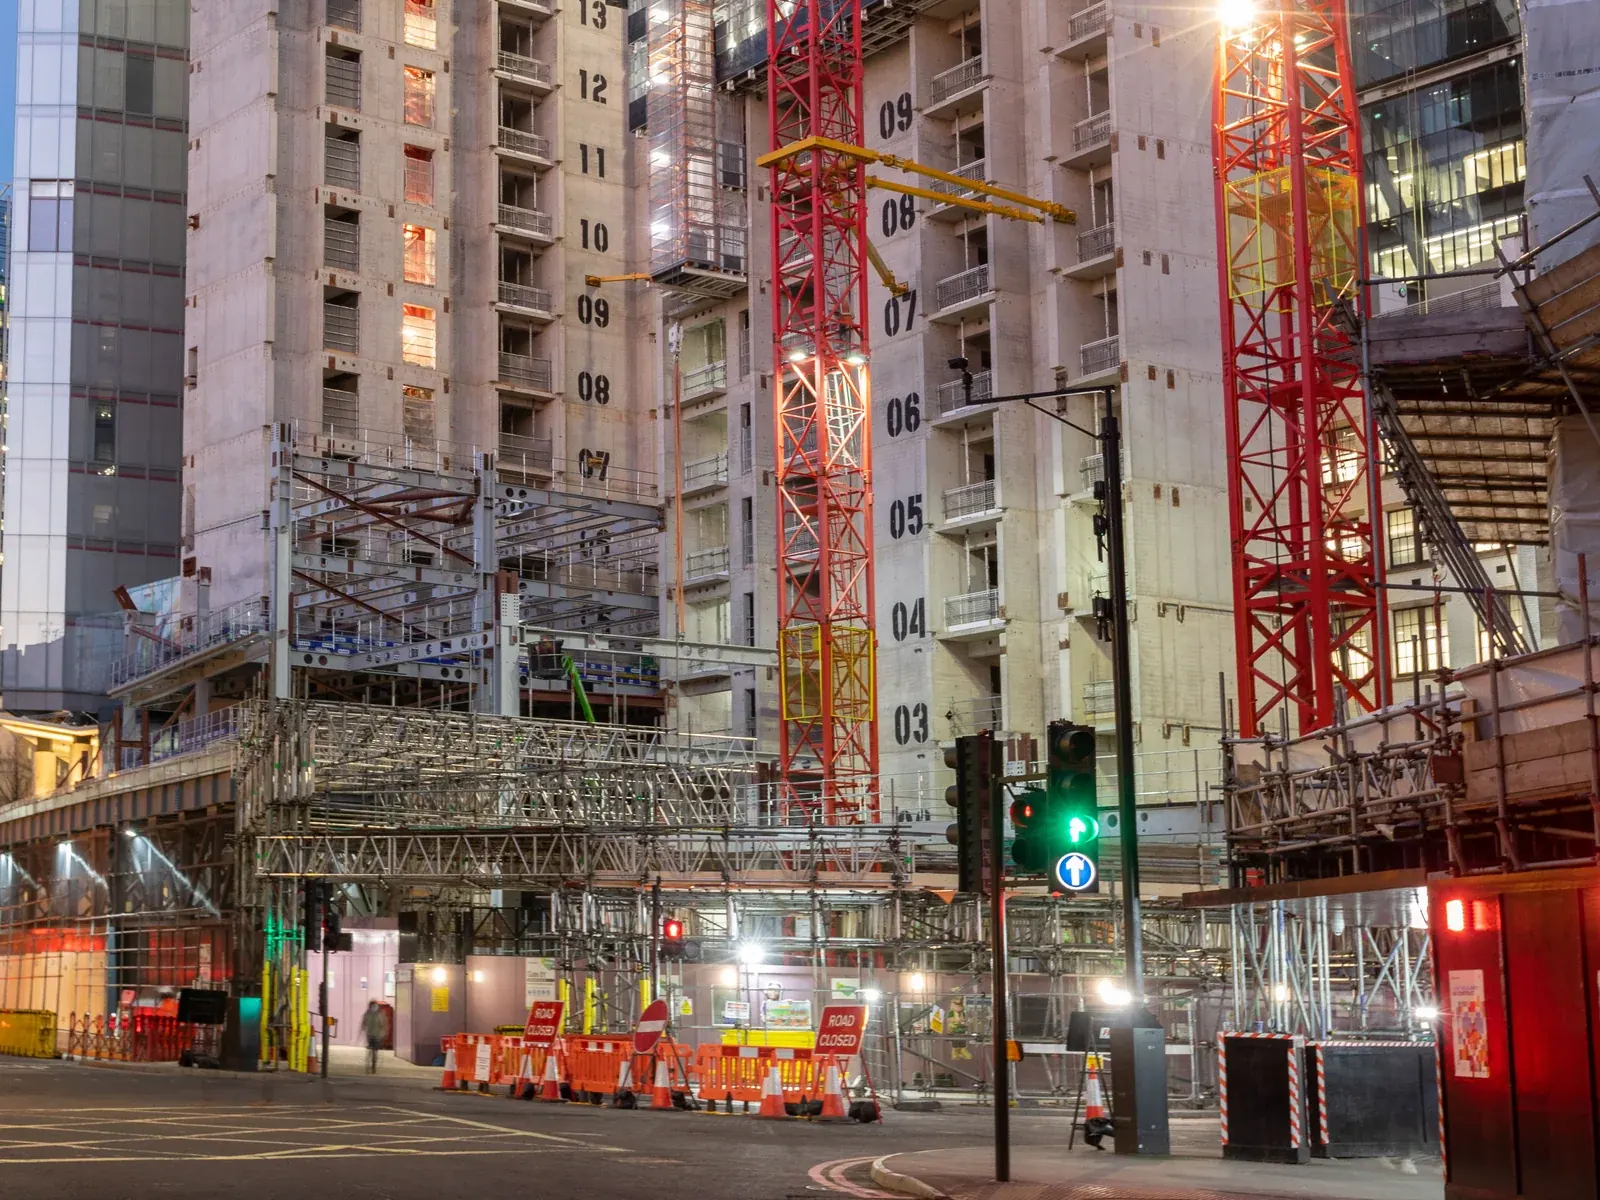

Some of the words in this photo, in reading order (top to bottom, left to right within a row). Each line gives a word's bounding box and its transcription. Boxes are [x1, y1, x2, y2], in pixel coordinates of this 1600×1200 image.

[579, 68, 608, 105] 12
[879, 91, 914, 140] 09
[580, 143, 605, 178] 11
[882, 193, 916, 238] 08
[580, 218, 609, 253] 10
[578, 294, 609, 328] 09
[884, 289, 918, 337] 07
[578, 371, 610, 405] 08
[887, 392, 921, 438] 06
[579, 448, 610, 482] 07
[890, 493, 924, 540] 05
[892, 597, 925, 642] 04
[894, 702, 929, 746] 03
[527, 1025, 556, 1036] CLOSED
[535, 1008, 556, 1019] ROAD
[828, 1014, 856, 1027] ROAD
[819, 1034, 857, 1047] CLOSED
